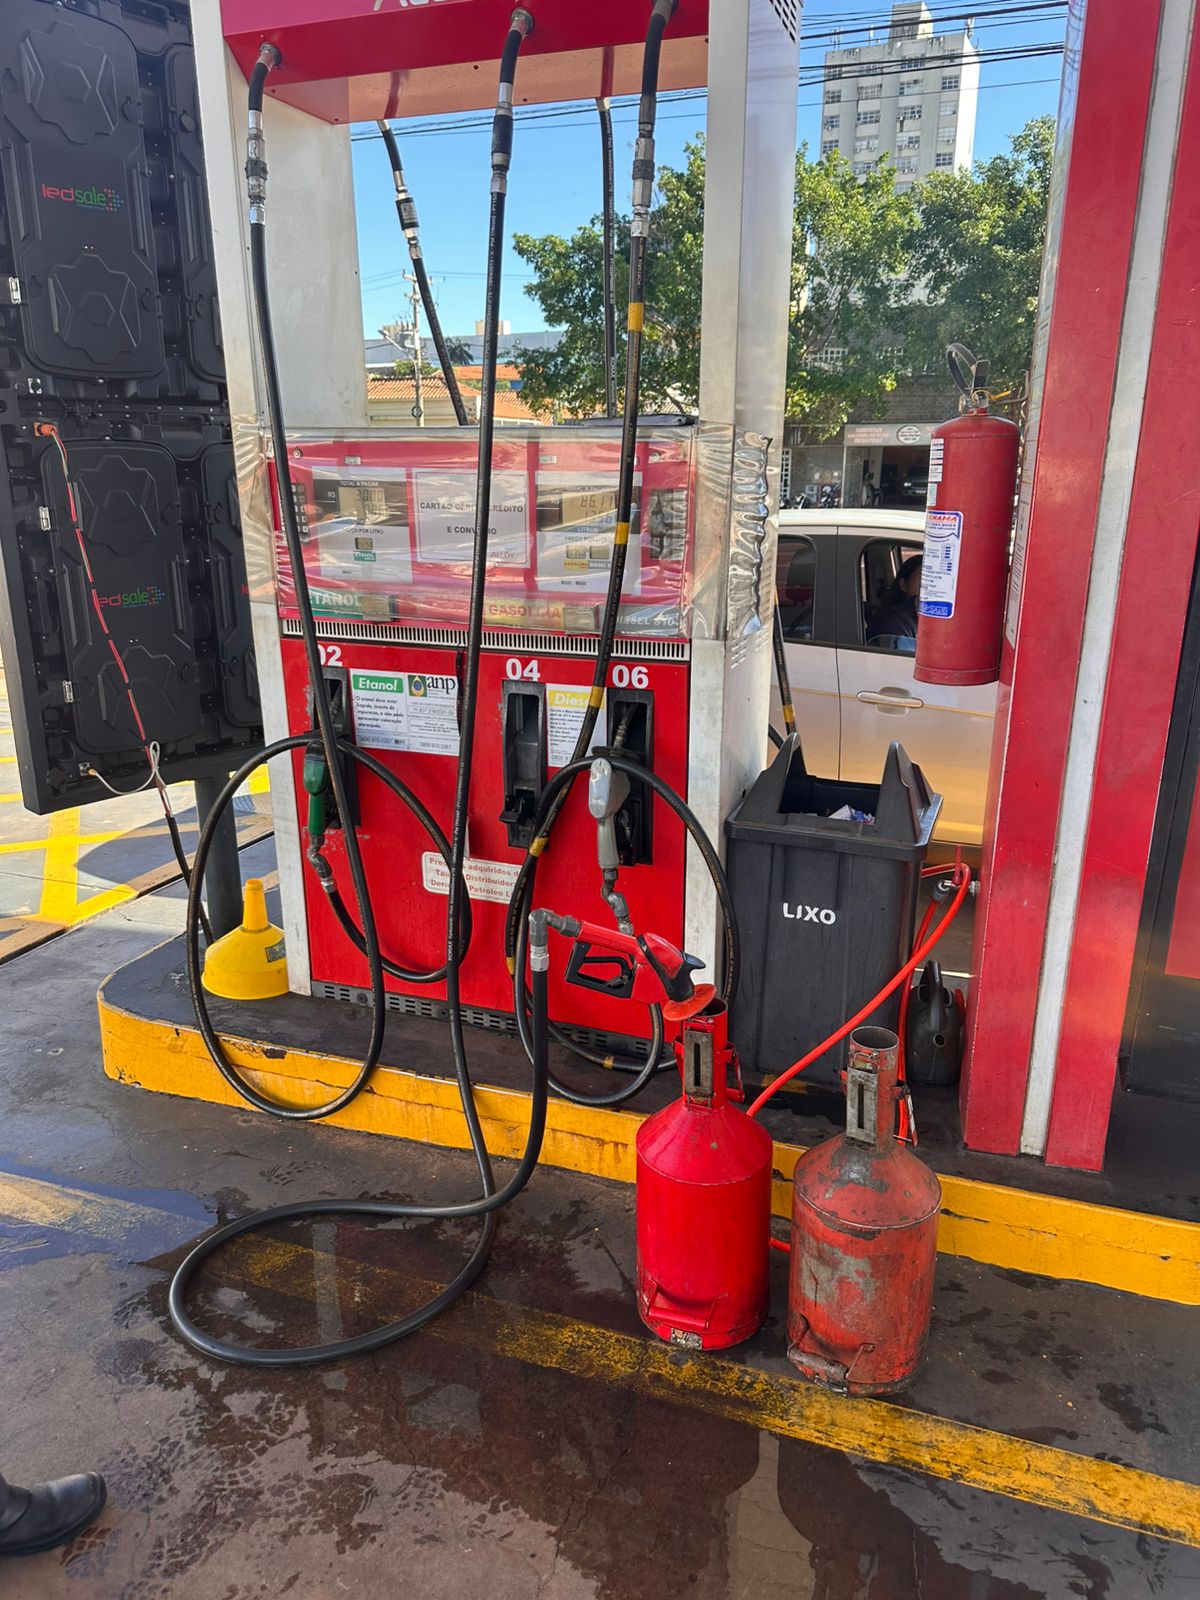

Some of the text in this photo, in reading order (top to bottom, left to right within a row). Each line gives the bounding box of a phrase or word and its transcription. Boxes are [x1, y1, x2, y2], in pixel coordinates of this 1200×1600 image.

[505, 658, 541, 682] 04
[612, 664, 649, 689] 06
[358, 677, 398, 691] Etanol
[427, 676, 456, 695] anp
[468, 864, 512, 875] adquiridos
[465, 874, 514, 887] Distribuidor
[469, 885, 504, 896] Petróleo
[782, 902, 836, 925] LIXO
